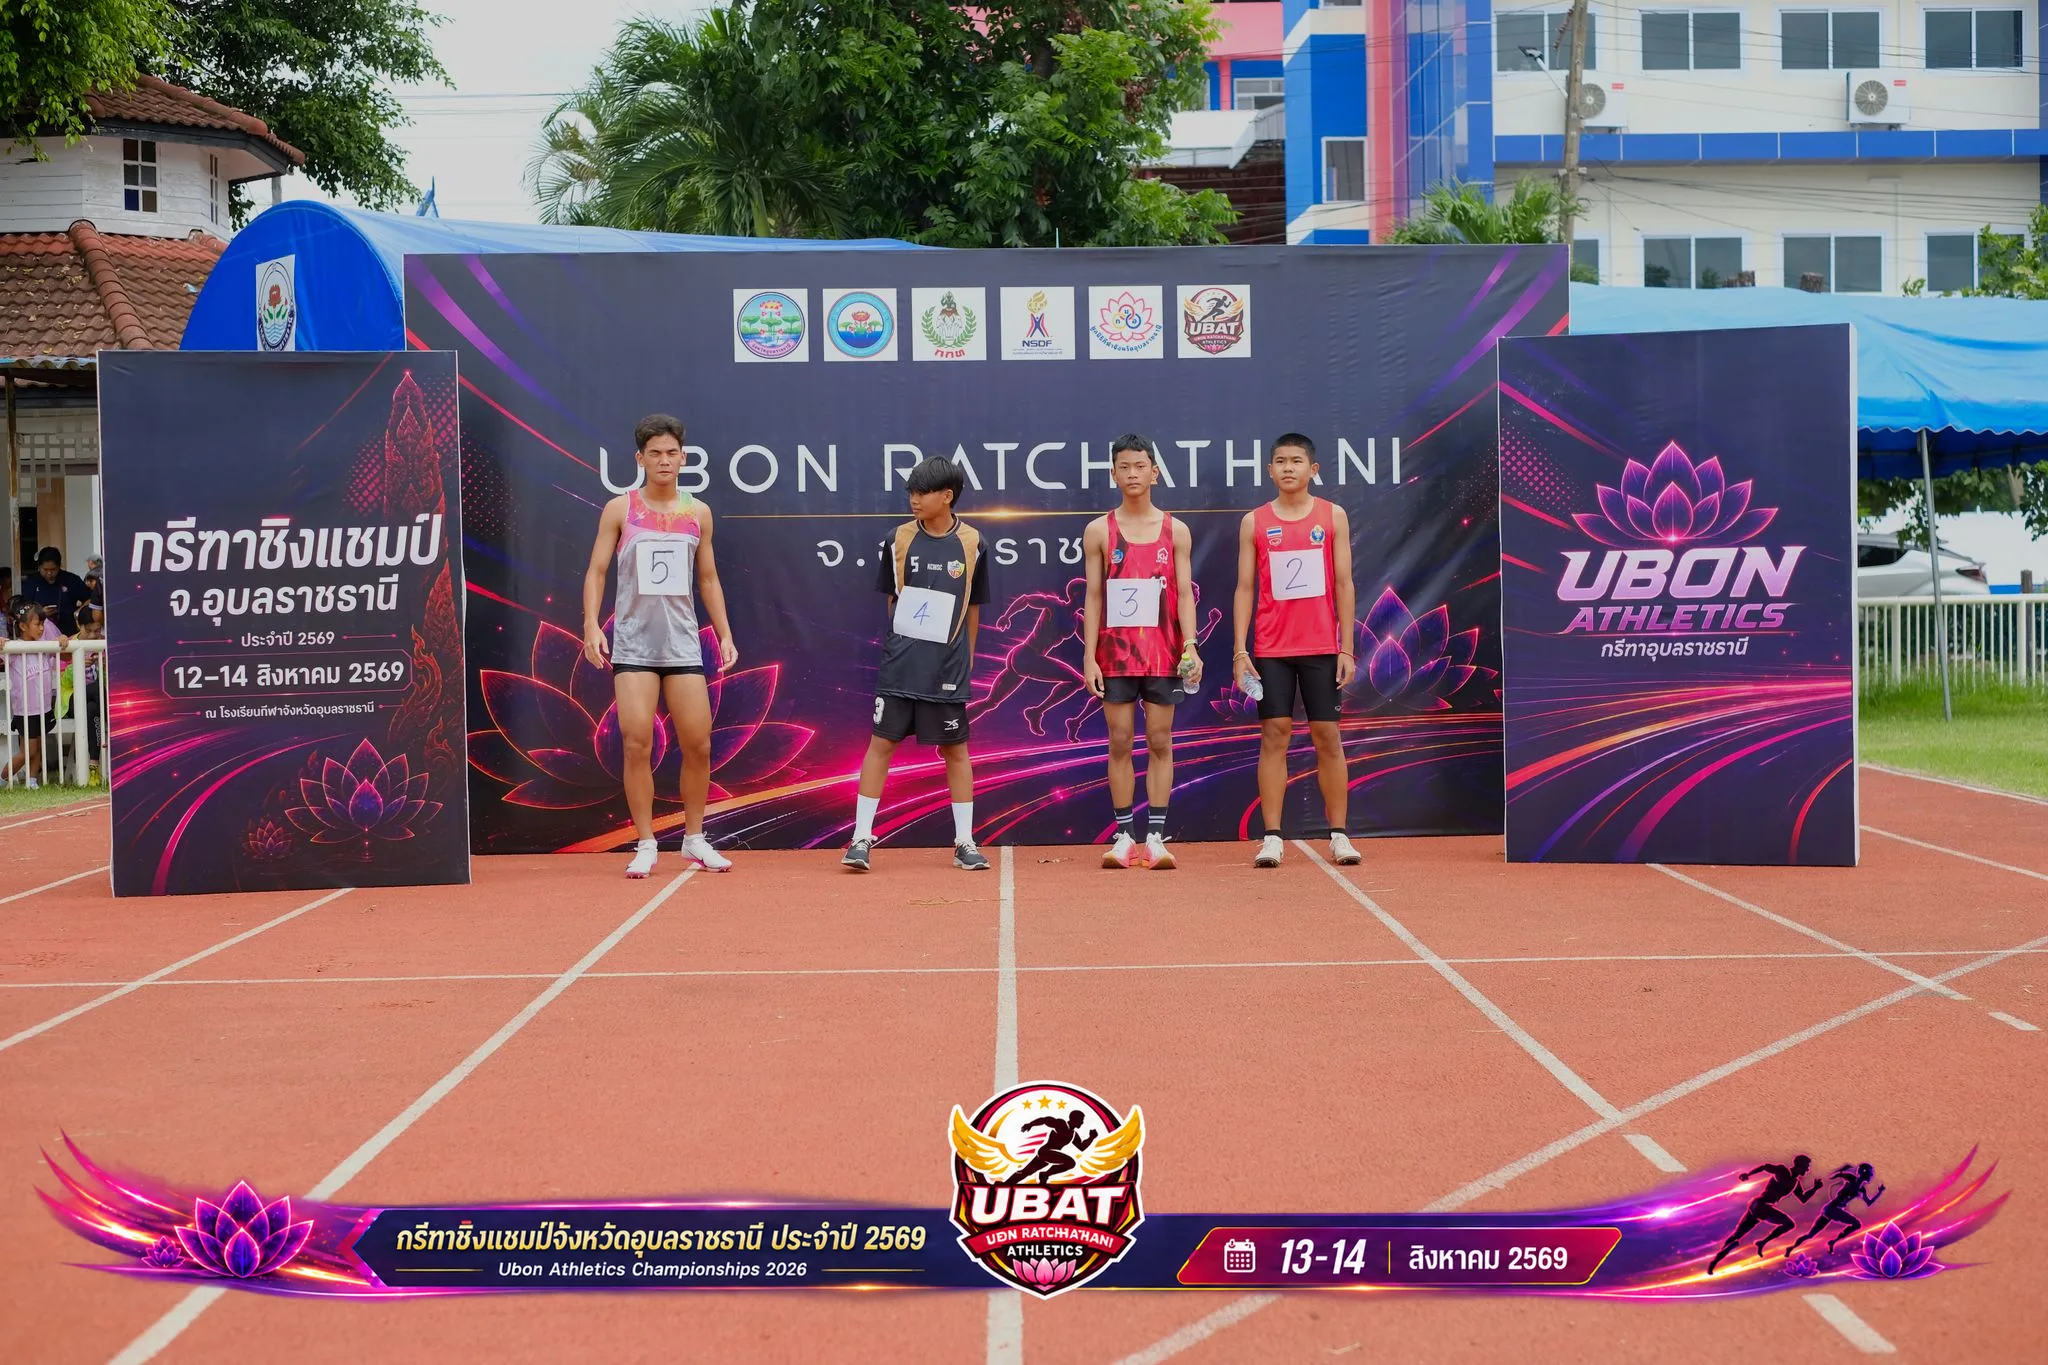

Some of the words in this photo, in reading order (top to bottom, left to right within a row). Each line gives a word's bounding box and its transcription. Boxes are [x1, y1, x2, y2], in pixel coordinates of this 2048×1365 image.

[1189, 322, 1240, 336] UBAT
[651, 550, 674, 584] 5
[910, 556, 920, 573] 5
[1285, 557, 1308, 590] 2
[1557, 546, 1807, 601] UBON
[912, 600, 930, 626] 4
[1119, 588, 1138, 618] 3
[1558, 603, 1799, 635] ATHLETICS
[241, 631, 293, 647] ประจำปี
[298, 631, 335, 646] 2569
[256, 662, 341, 688] สิงหาคม
[348, 661, 404, 684] 2569
[205, 708, 217, 719] ณ
